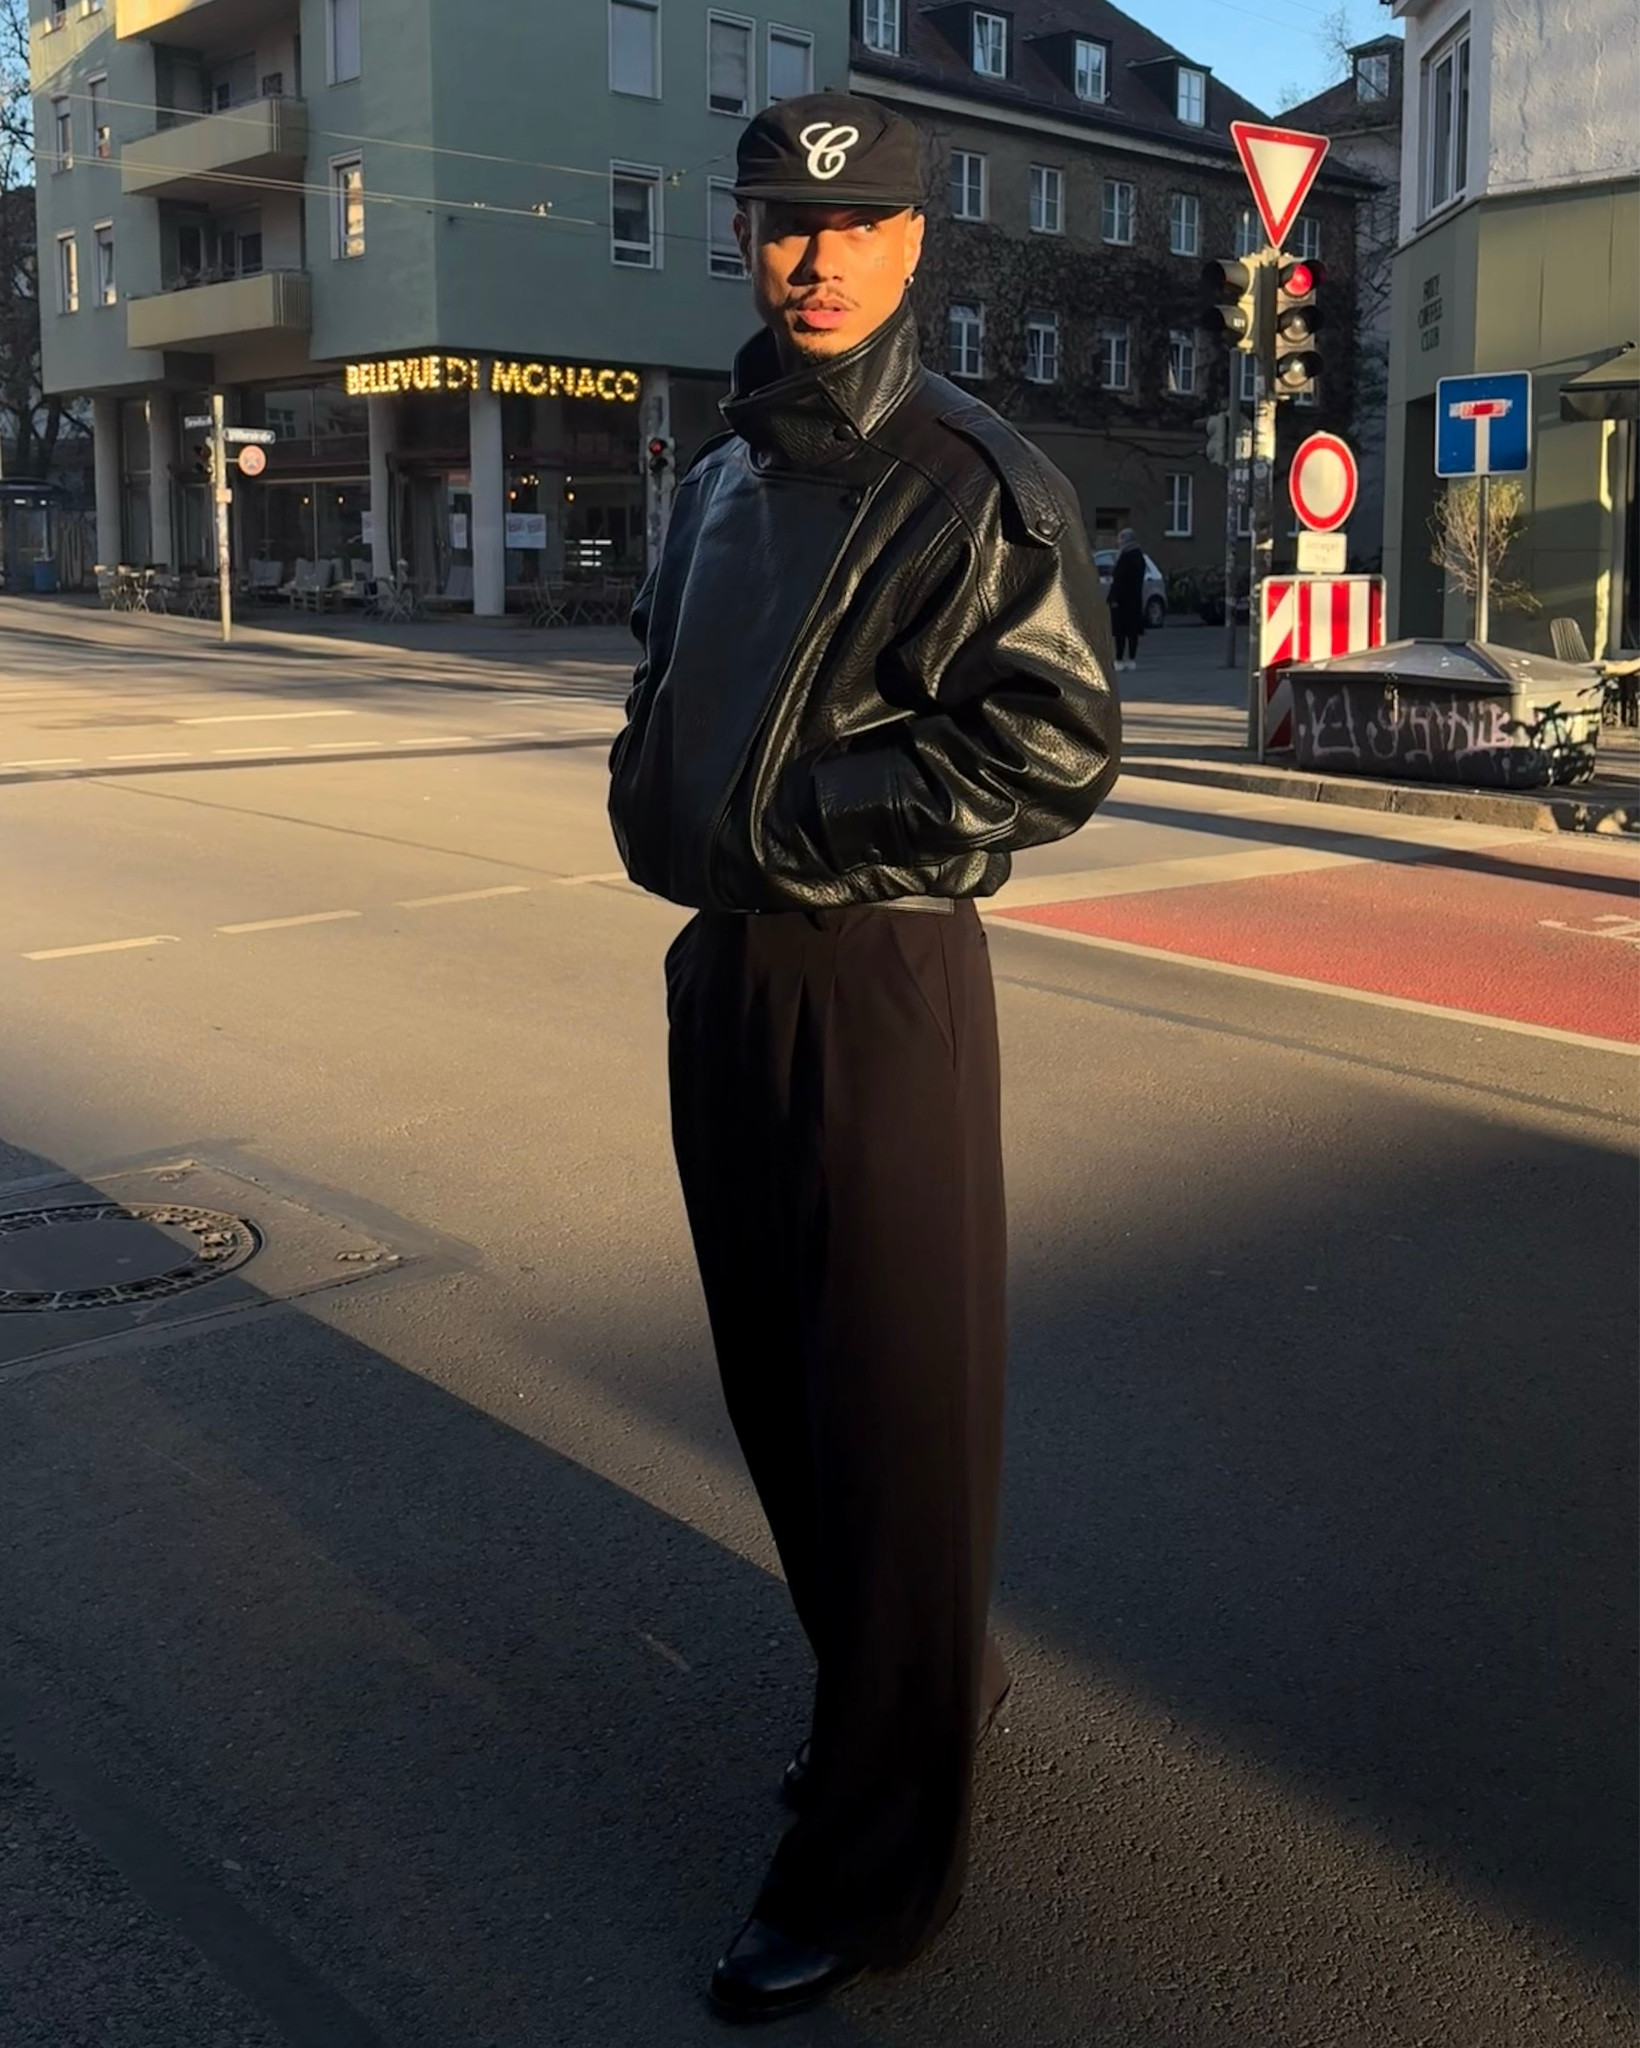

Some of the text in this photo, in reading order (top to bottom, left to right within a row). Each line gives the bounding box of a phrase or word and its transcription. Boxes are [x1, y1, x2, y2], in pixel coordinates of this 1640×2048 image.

[345, 355, 641, 401] BELLEVUE DI MONACO
